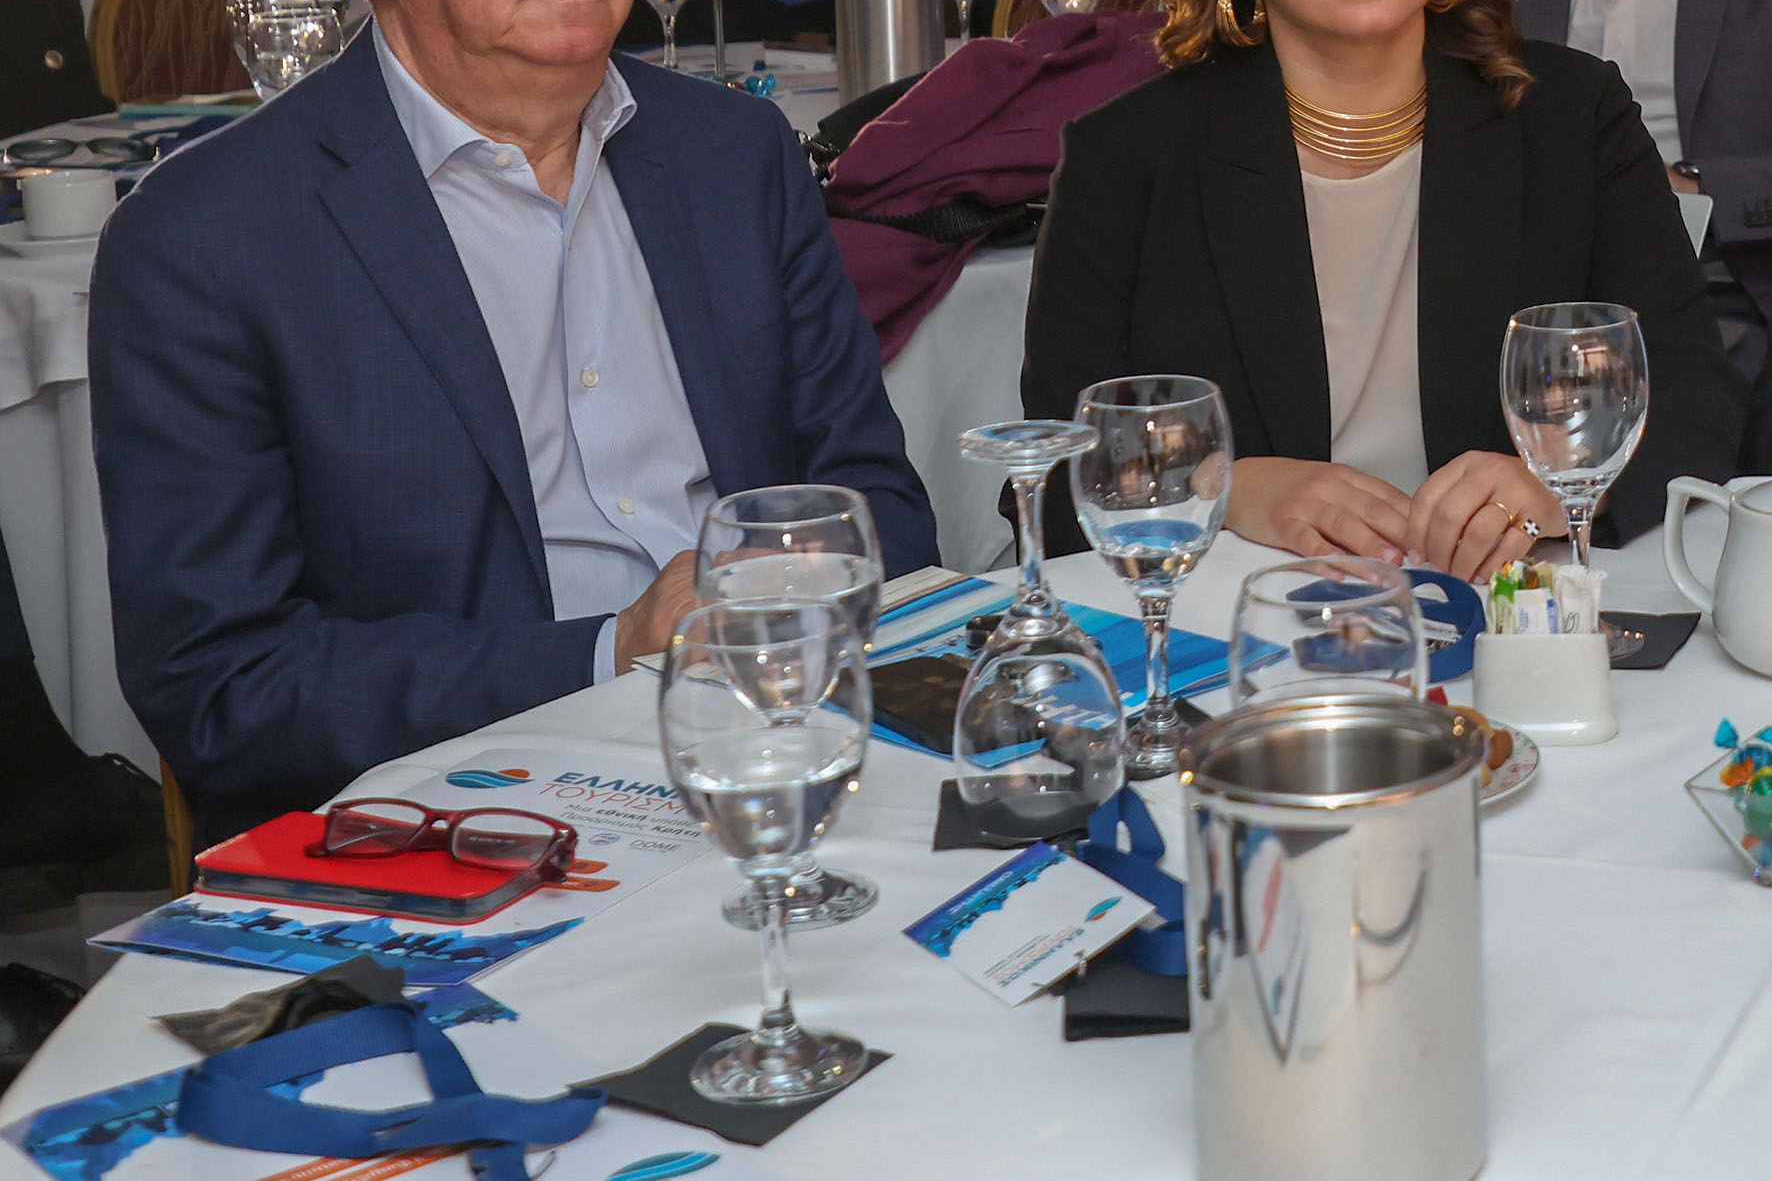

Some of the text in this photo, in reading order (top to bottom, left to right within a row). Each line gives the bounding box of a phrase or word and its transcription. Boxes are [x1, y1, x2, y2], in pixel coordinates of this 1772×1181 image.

[539, 783, 687, 815] ΤΟΥΡΙΣΜ
[552, 771, 681, 800] ΕΛΛΗΝ
[560, 811, 702, 838] Προορισμός Κρήτη
[595, 808, 649, 822] εθνική
[650, 816, 694, 828] υπόθε
[630, 839, 682, 852] DOME
